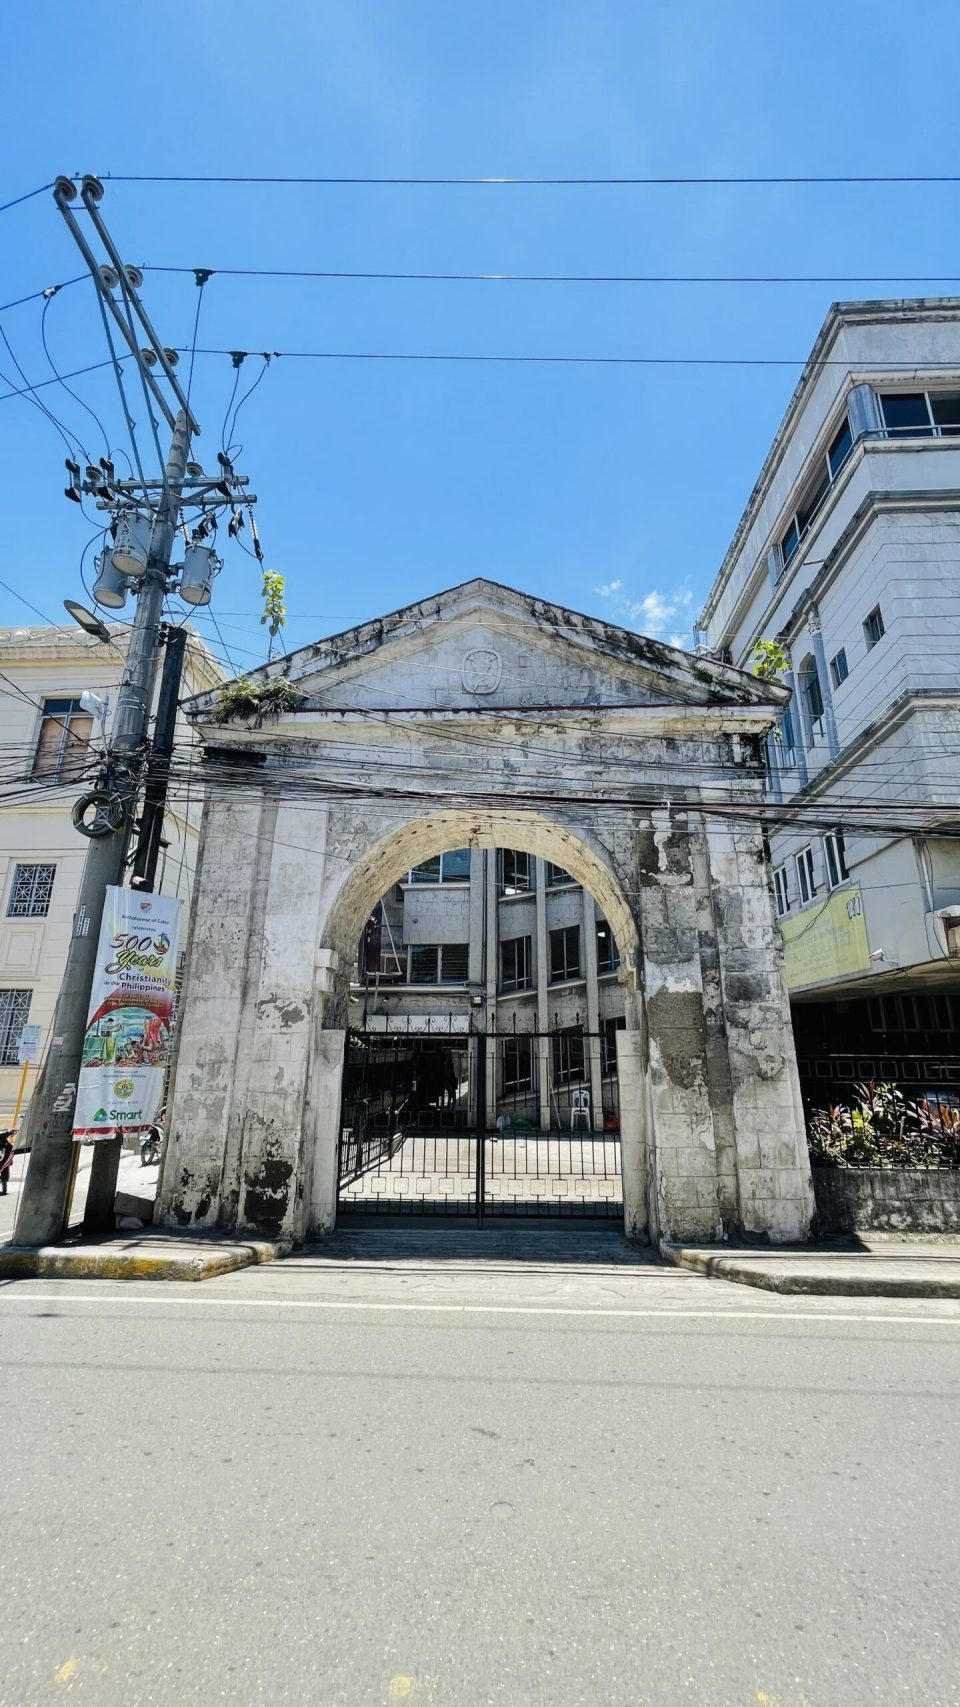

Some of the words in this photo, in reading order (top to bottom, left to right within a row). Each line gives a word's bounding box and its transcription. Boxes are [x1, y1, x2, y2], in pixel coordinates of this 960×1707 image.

[110, 933, 152, 952] 500
[105, 949, 164, 975] Years
[119, 973, 172, 987] Christianity
[121, 982, 165, 992] Philippines
[109, 1108, 143, 1121] Smart
